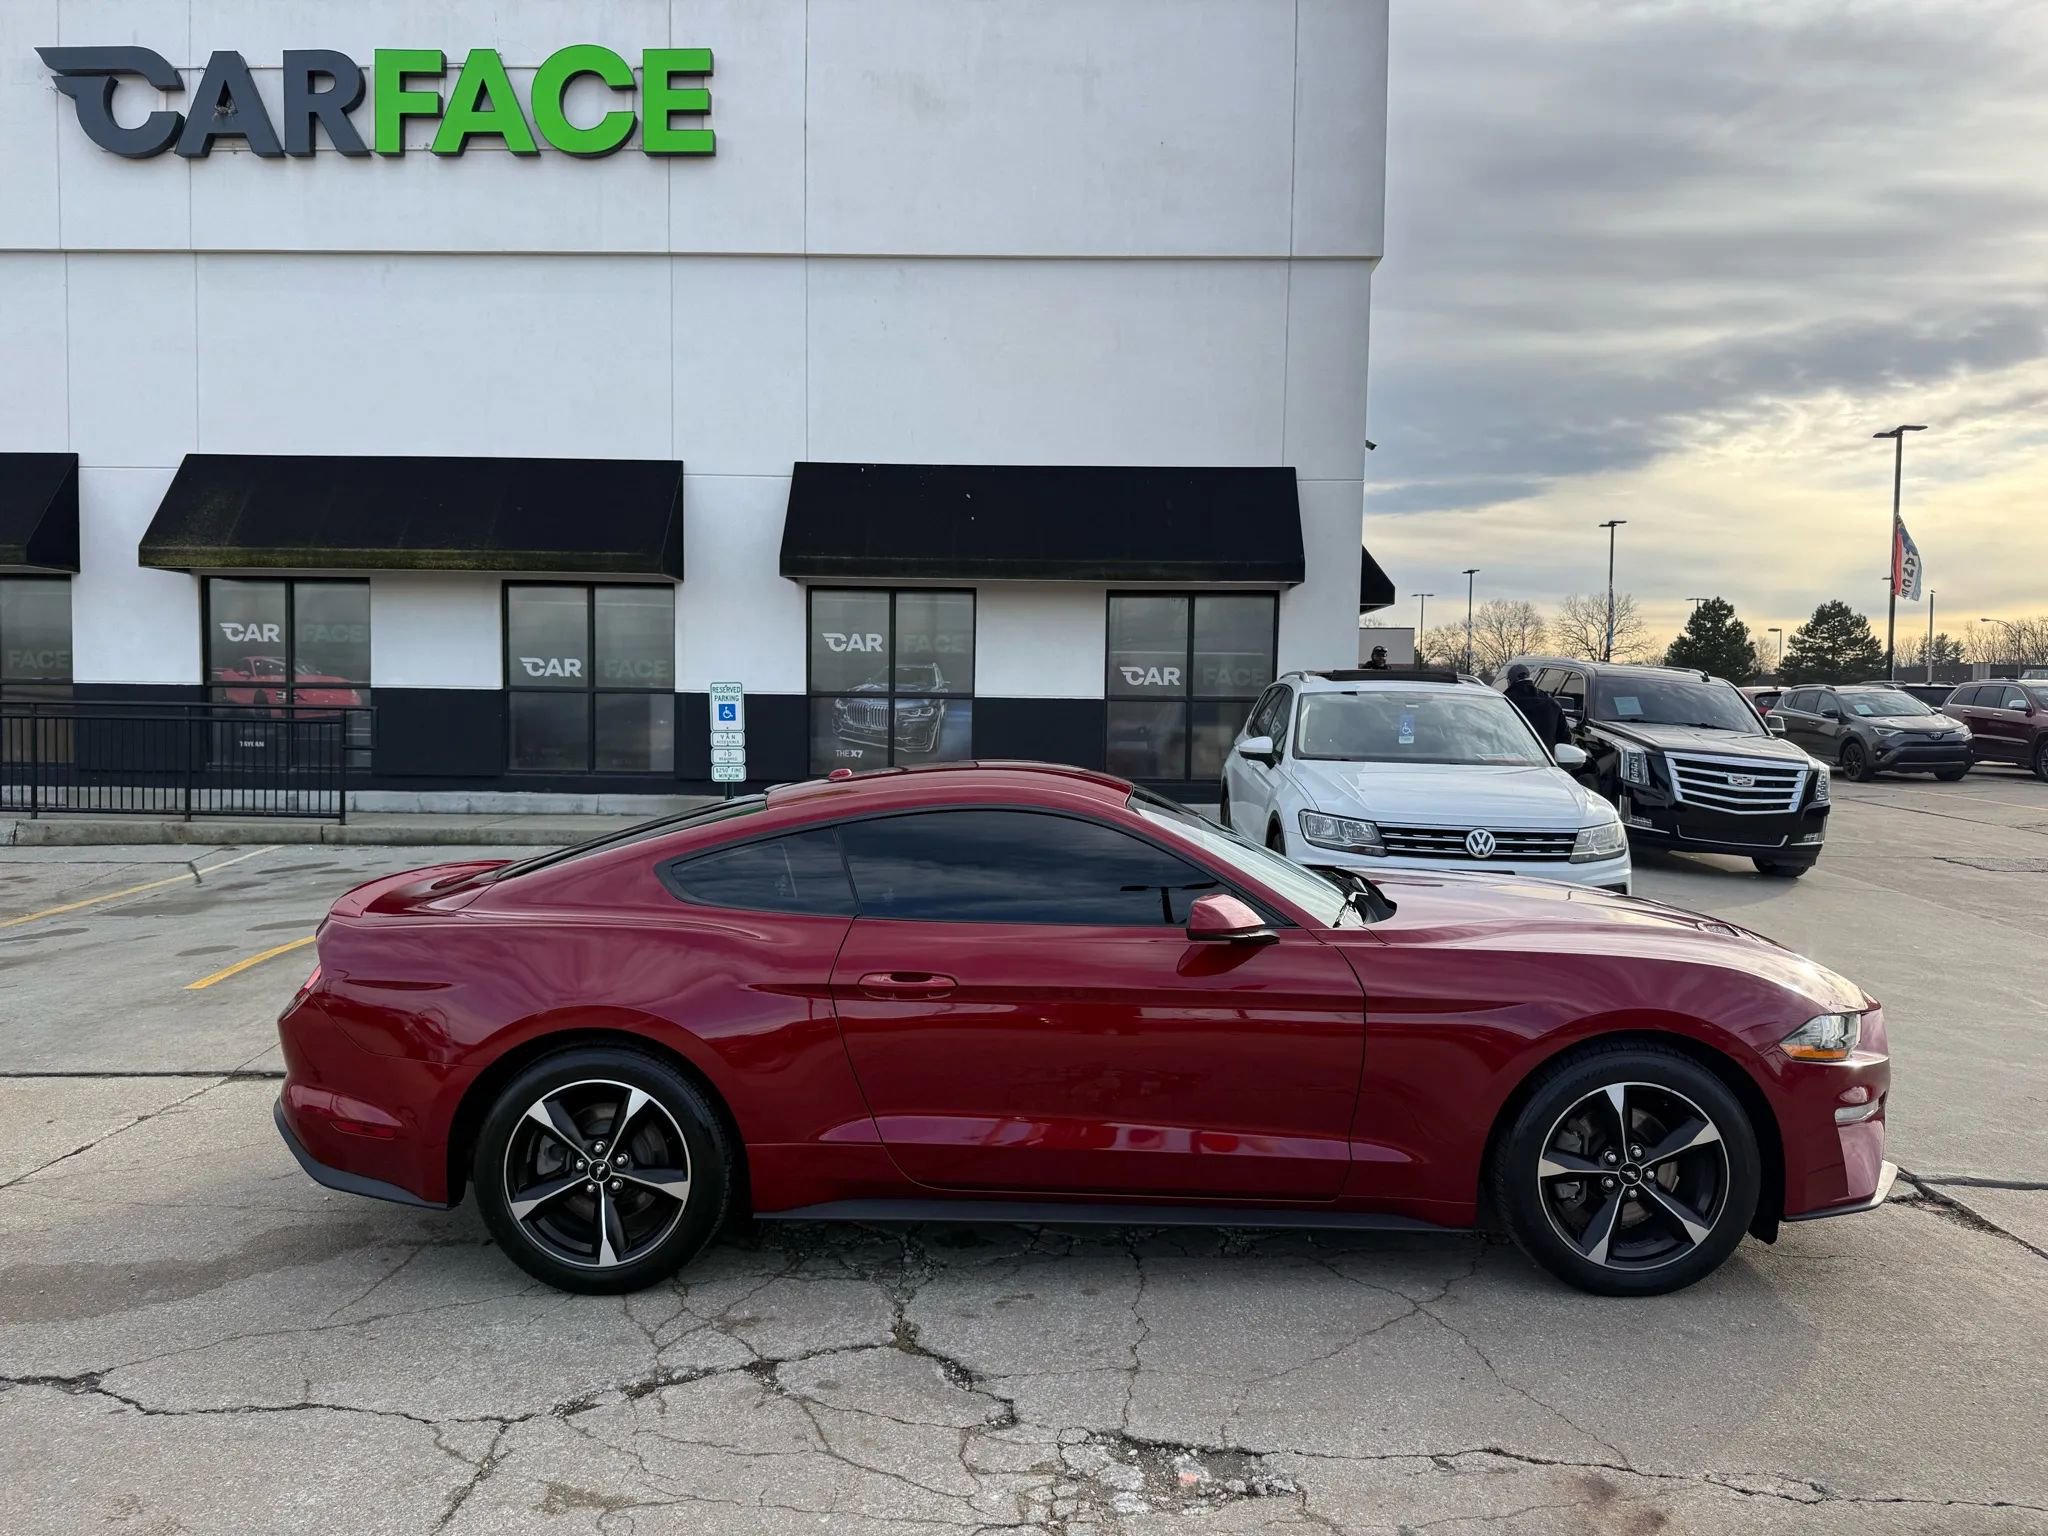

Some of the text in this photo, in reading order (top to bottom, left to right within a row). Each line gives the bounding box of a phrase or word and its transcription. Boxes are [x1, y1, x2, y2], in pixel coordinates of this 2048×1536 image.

[34, 44, 717, 158] CARFACE
[219, 622, 280, 643] CAR
[822, 632, 883, 652] CAR
[8, 649, 71, 670] FACE
[519, 657, 582, 677] CAR
[1119, 666, 1181, 686] CAR
[712, 686, 741, 694] RESERVED
[835, 750, 863, 758] THE X7
